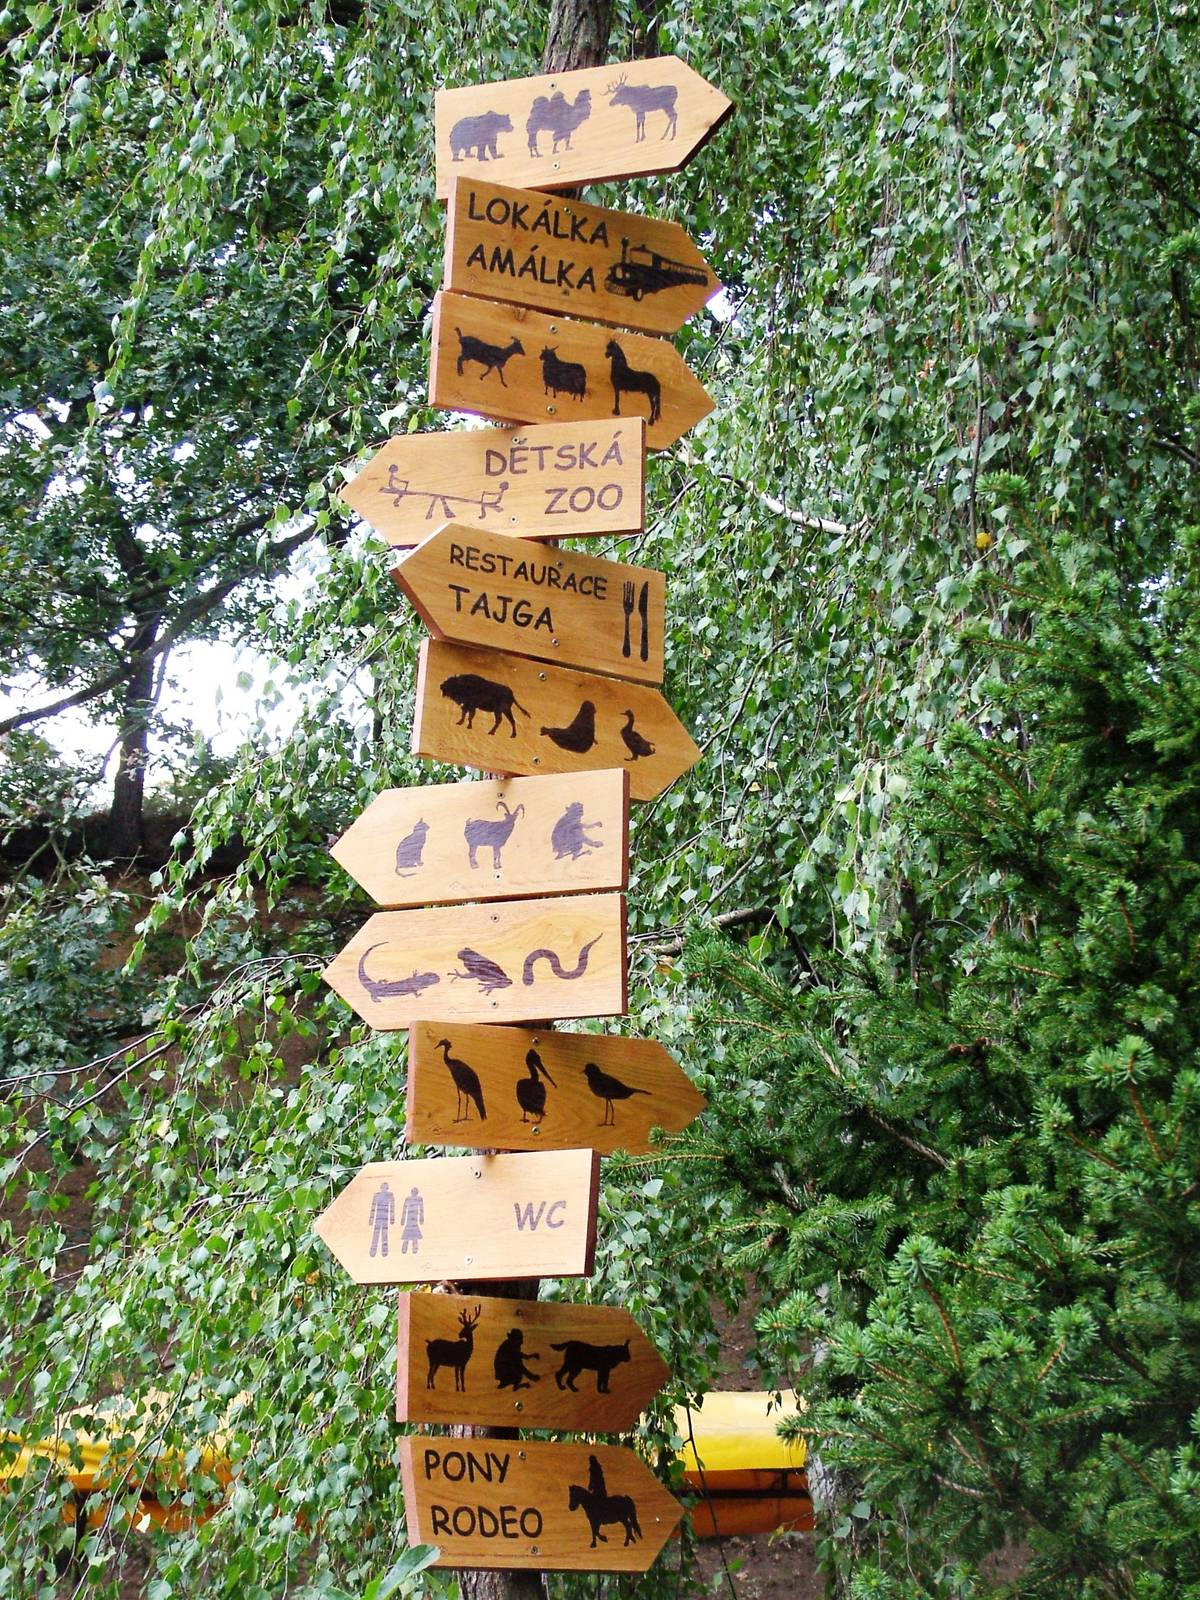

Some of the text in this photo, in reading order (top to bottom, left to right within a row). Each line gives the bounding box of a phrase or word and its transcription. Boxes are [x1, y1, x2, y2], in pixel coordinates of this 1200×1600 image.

[468, 191, 608, 248] LOKÁLKA
[466, 244, 596, 292] AMÁLKA
[485, 430, 624, 476] DĚTSKÁ
[544, 483, 624, 515] ZOO
[450, 543, 608, 600] RESTAURACE
[448, 583, 554, 633] TAJGA
[514, 1200, 567, 1231] WC
[424, 1449, 510, 1483] PONY
[430, 1505, 543, 1539] RODEO
